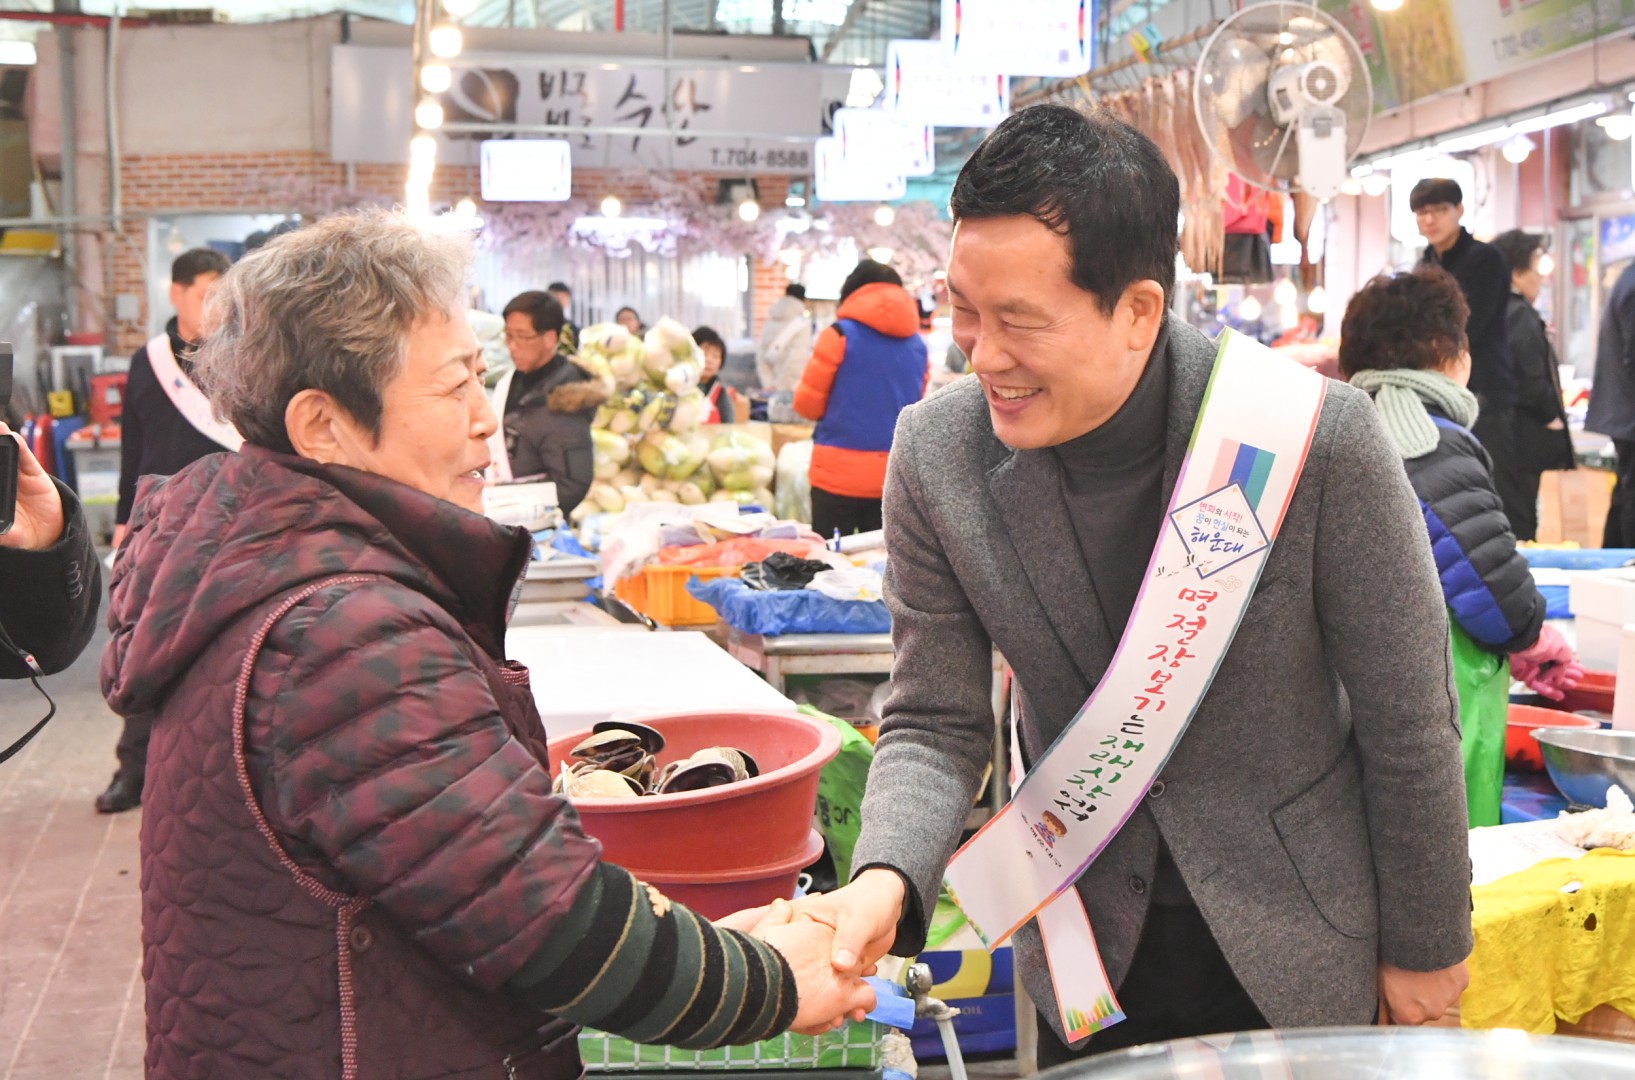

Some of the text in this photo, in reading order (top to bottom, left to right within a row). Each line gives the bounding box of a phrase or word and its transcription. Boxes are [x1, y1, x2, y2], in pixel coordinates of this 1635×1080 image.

[614, 73, 711, 153] 수산
[1195, 513, 1250, 538] 꿈이 현실이 되는
[1199, 502, 1243, 524] 변화의 시작!
[1190, 526, 1245, 553] 해운대
